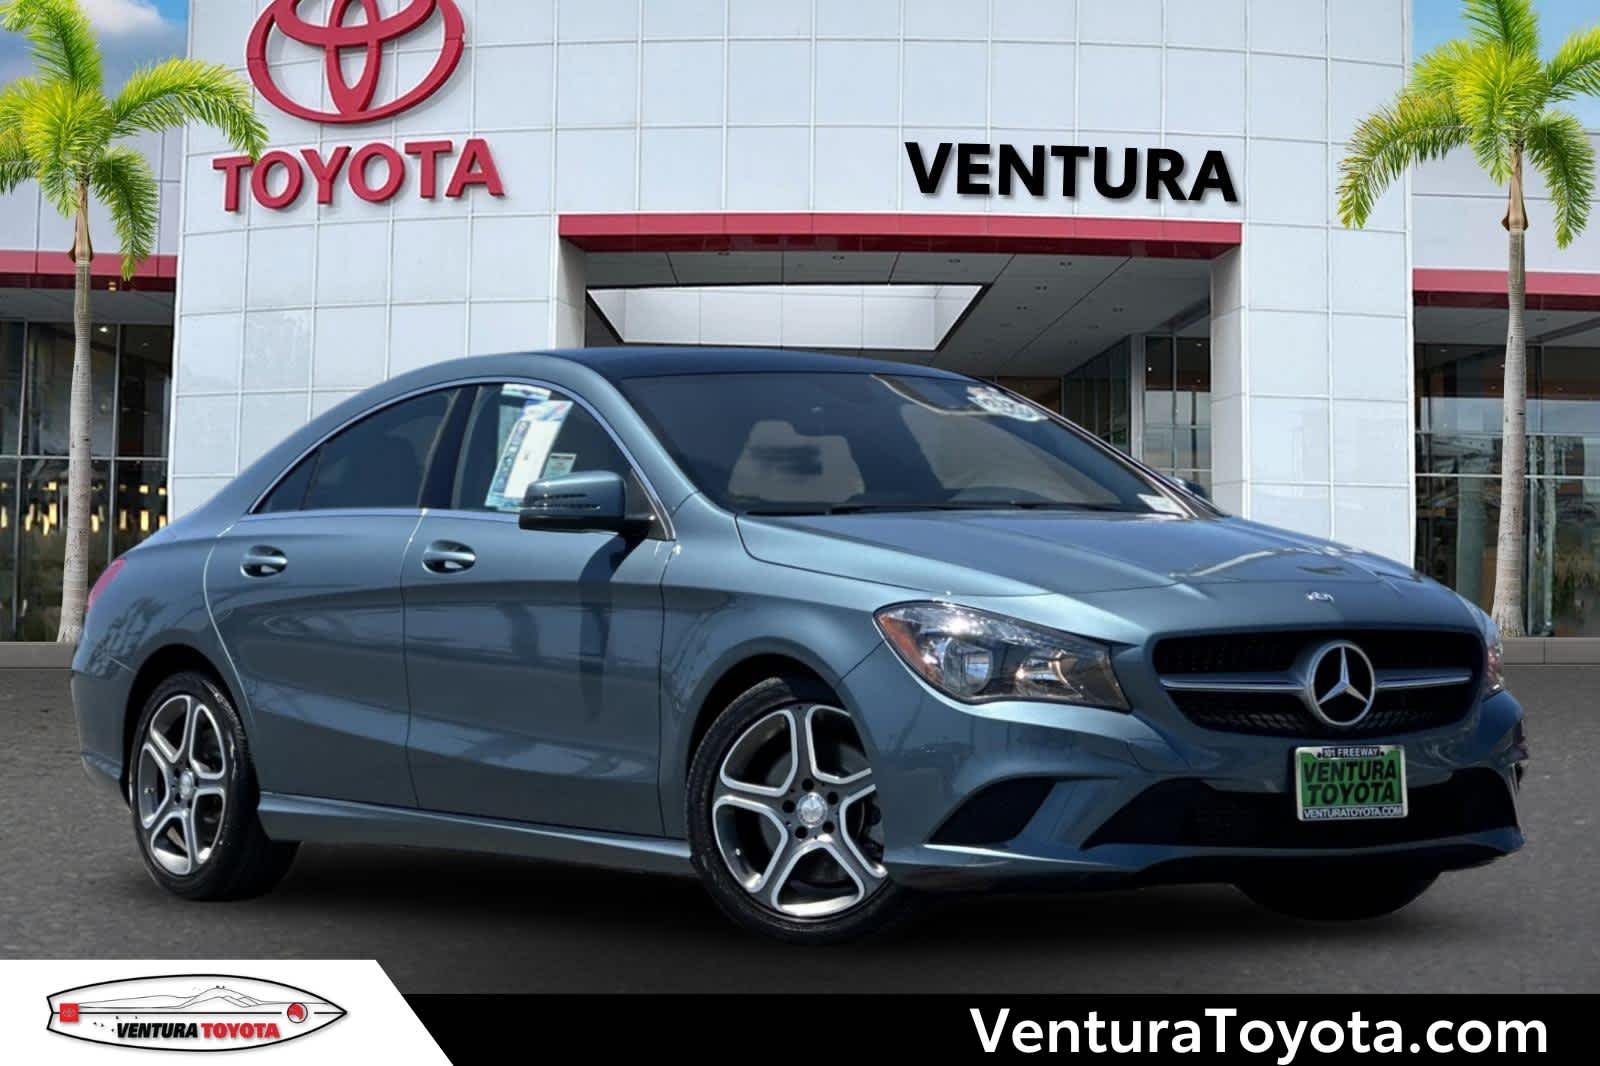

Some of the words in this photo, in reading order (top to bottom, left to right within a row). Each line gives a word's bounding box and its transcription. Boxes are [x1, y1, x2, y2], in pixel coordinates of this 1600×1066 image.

[212, 138, 505, 212] TOYOTA
[904, 141, 1239, 202] VENTURA
[1337, 747, 1379, 758] FREEWAY
[1303, 760, 1397, 782] VENTURA
[1307, 782, 1396, 806] TOYOTA
[1303, 806, 1403, 819] VENTURATOYOTA.COM
